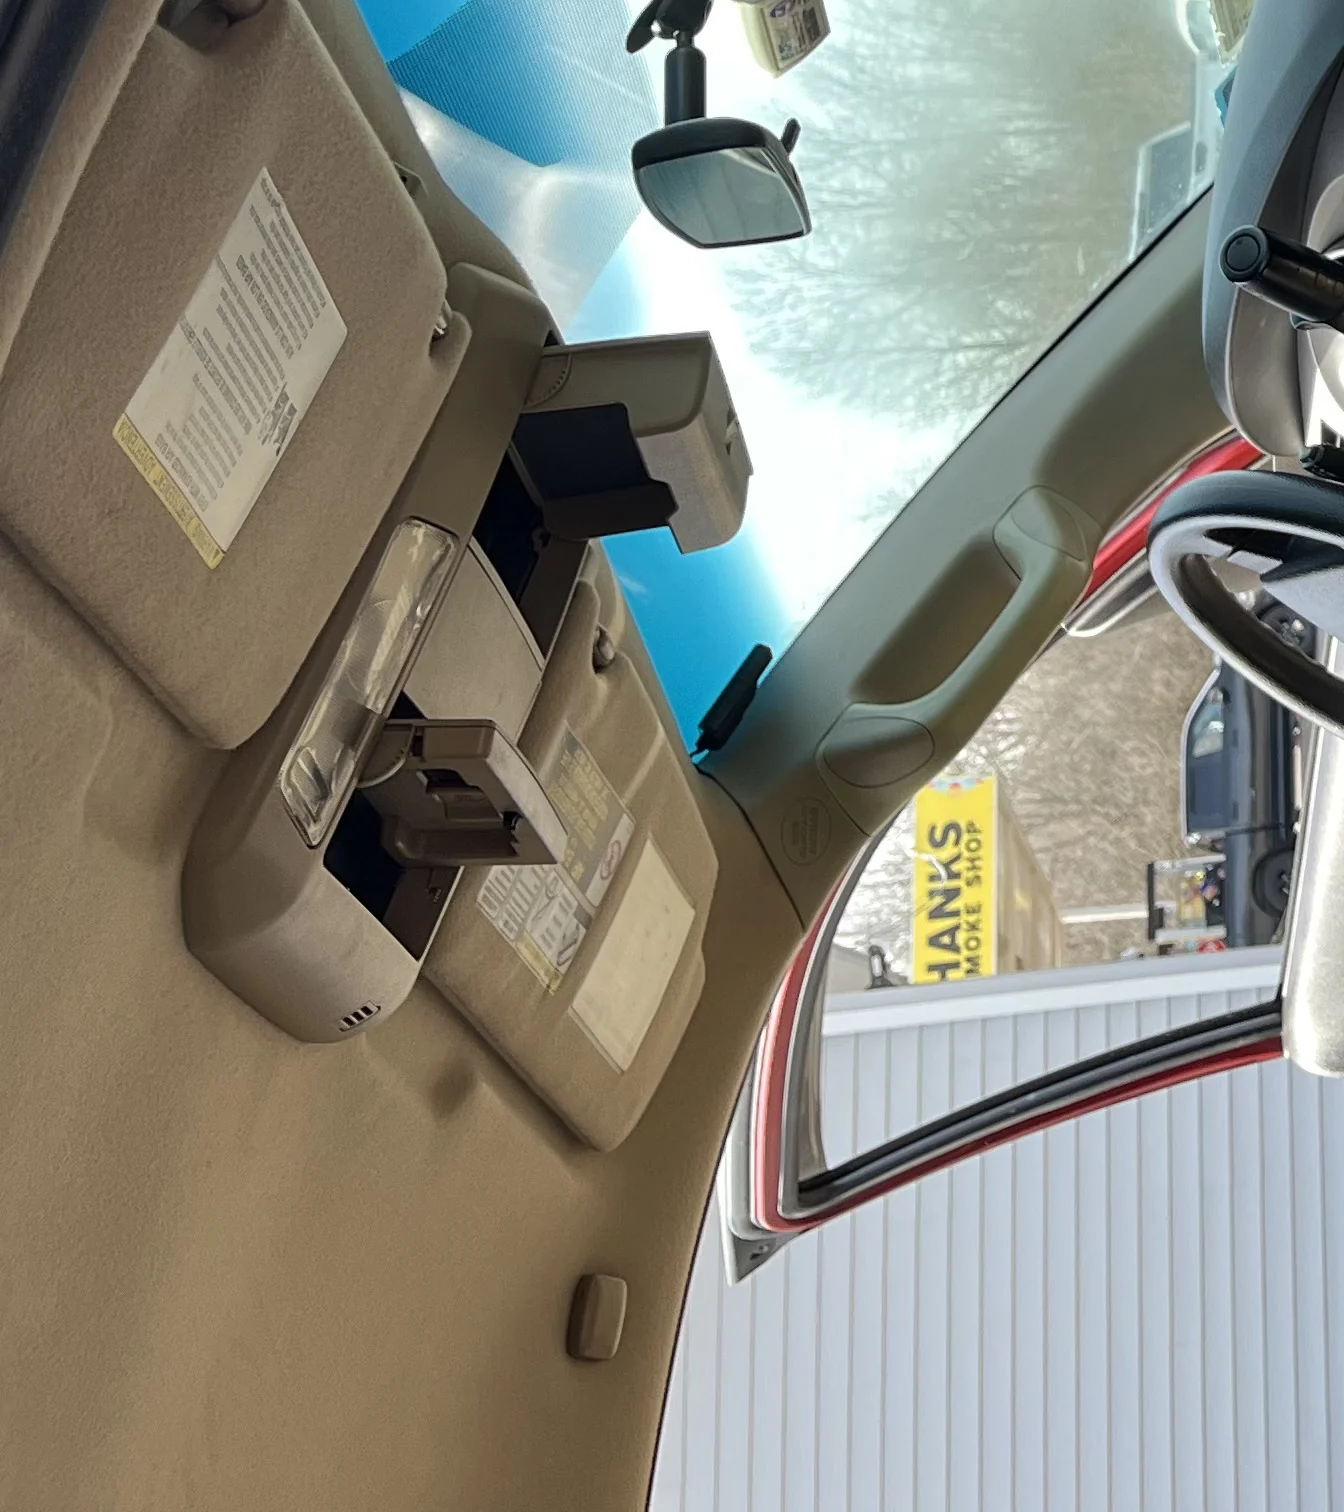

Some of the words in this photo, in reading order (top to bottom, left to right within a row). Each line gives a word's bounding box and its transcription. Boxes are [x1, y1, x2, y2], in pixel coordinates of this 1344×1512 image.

[964, 820, 982, 887] SHOP
[927, 822, 962, 982] HANKS
[964, 902, 982, 977] MOKE
